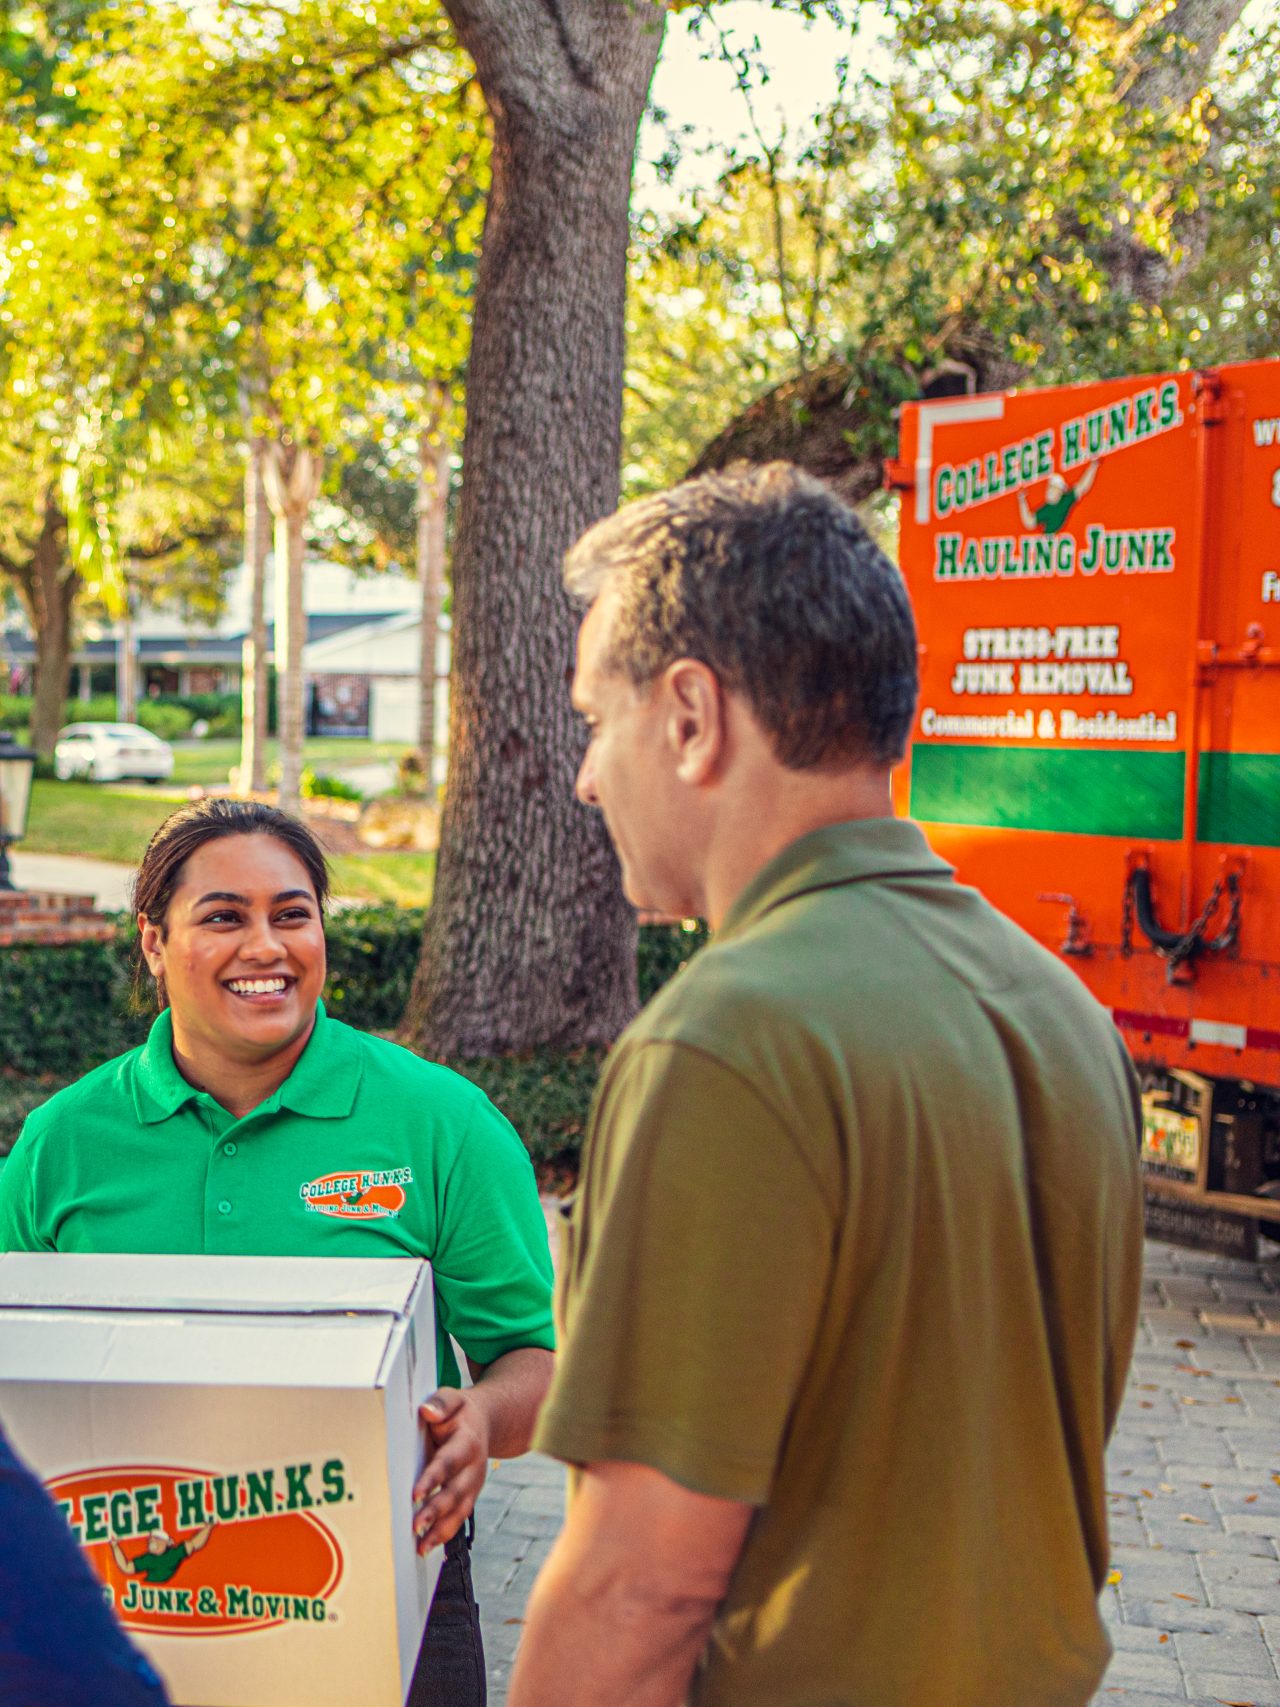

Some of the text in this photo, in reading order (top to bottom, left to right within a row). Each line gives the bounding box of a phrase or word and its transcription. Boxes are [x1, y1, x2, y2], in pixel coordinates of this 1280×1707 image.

[936, 432, 1053, 513] COLLEGE
[937, 527, 1173, 576] HAULING JUNK
[952, 661, 1133, 695] JUNK REMOVAL
[921, 706, 1177, 742] Commercial & Residential
[301, 1178, 357, 1198] COLLEGE
[176, 1459, 355, 1526] H.U.N.K.S.
[123, 1583, 191, 1613] JUNK
[198, 1588, 219, 1614] &
